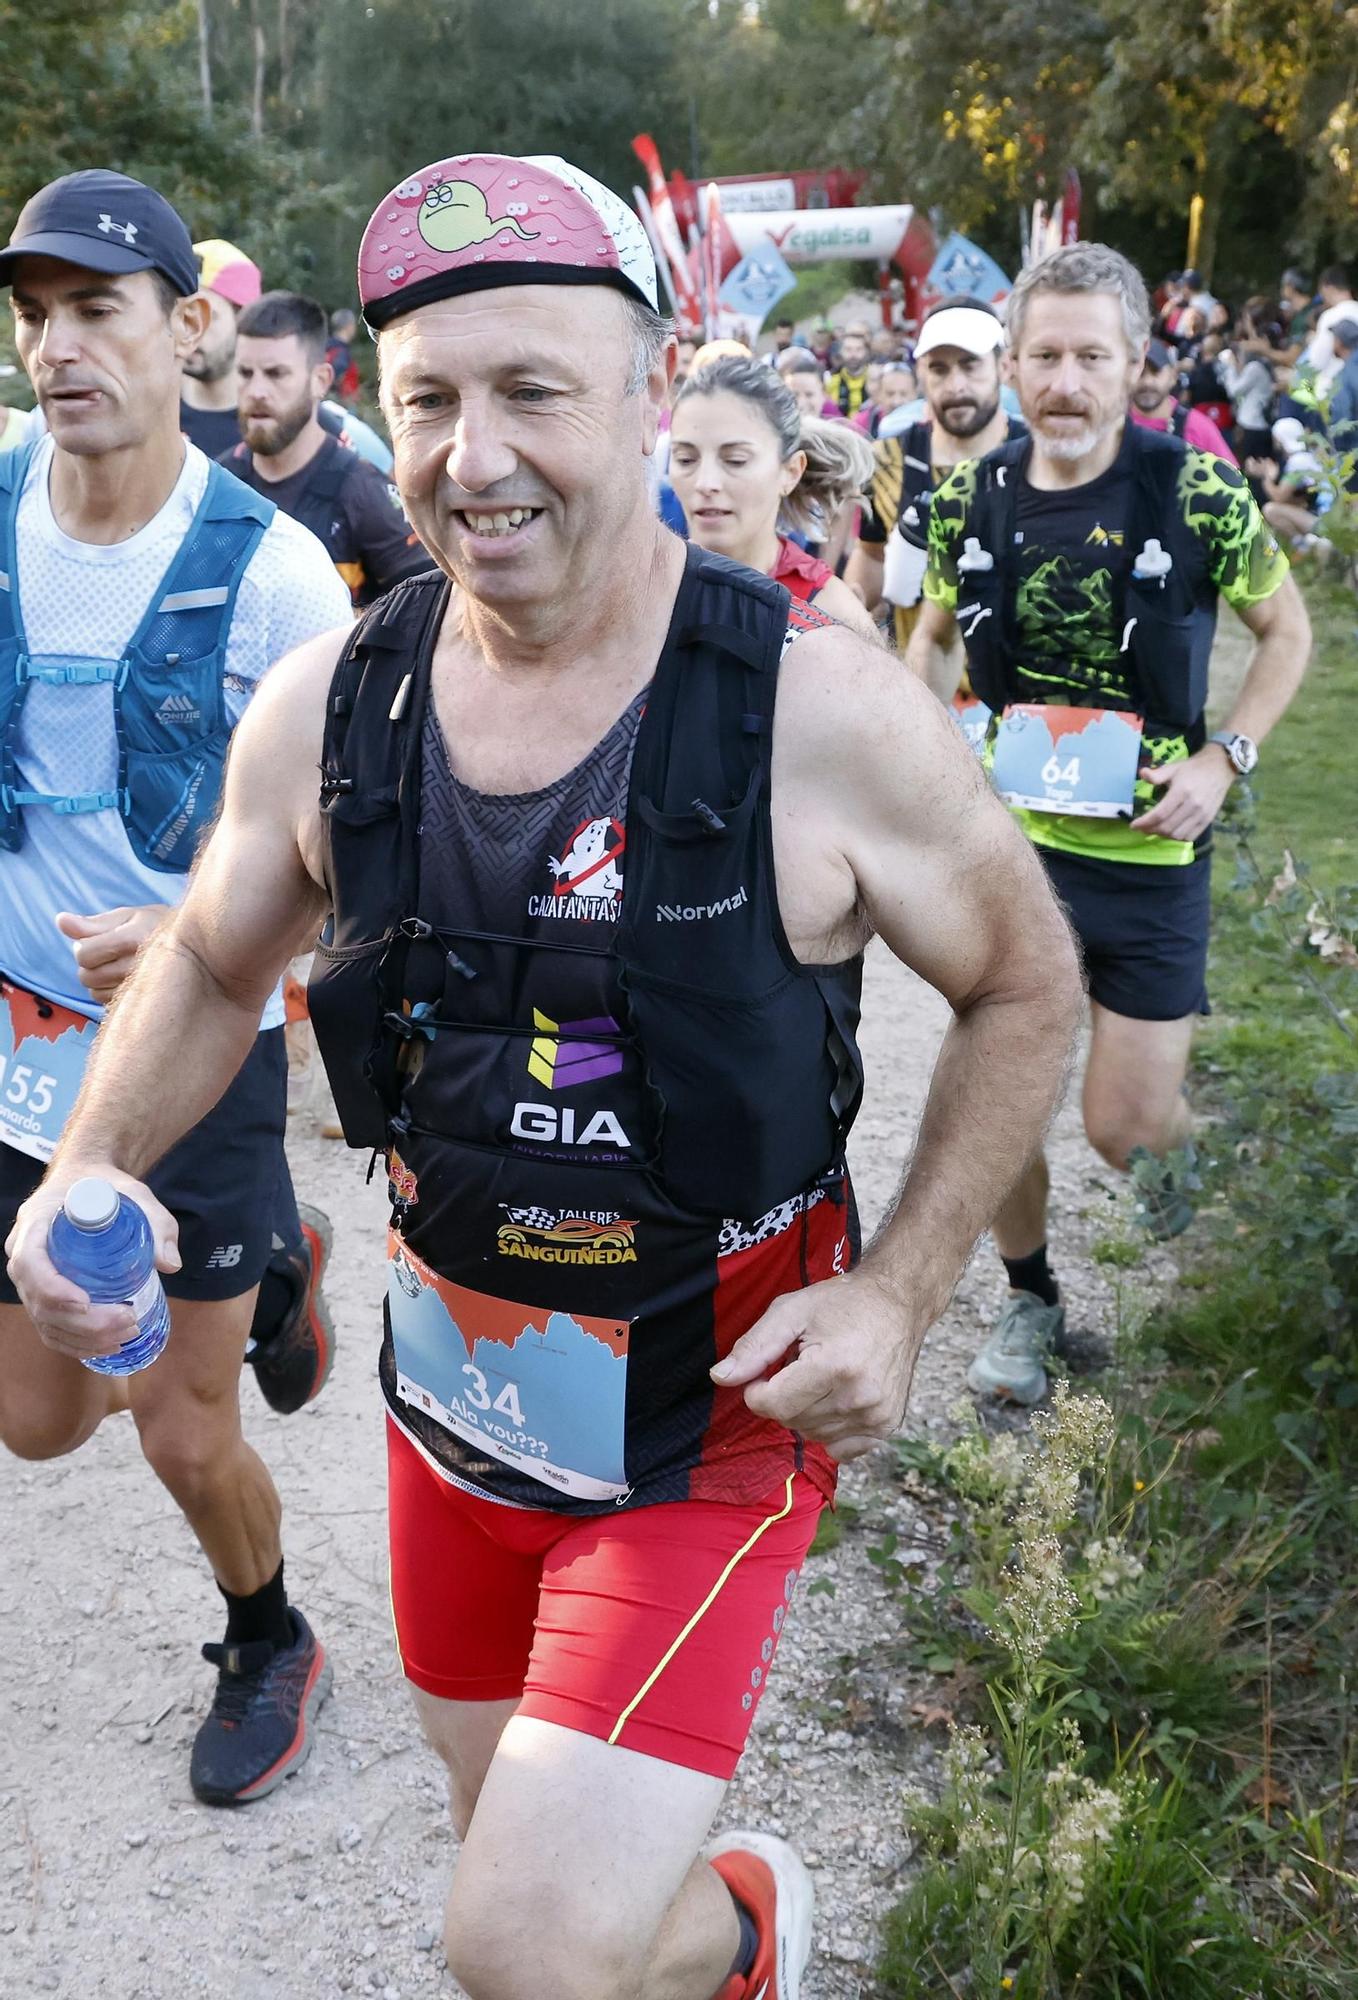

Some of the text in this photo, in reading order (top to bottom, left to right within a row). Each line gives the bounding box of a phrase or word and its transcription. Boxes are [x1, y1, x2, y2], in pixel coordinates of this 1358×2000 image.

[765, 222, 872, 251] Vegalsa
[1041, 754, 1080, 785] 64
[510, 1102, 631, 1147] GIA
[558, 1209, 620, 1226] TALLERES
[497, 1239, 637, 1265] SANGUIÑEDA
[461, 1363, 526, 1428] 34
[450, 1396, 479, 1426] Ala
[483, 1420, 549, 1459] vou???
